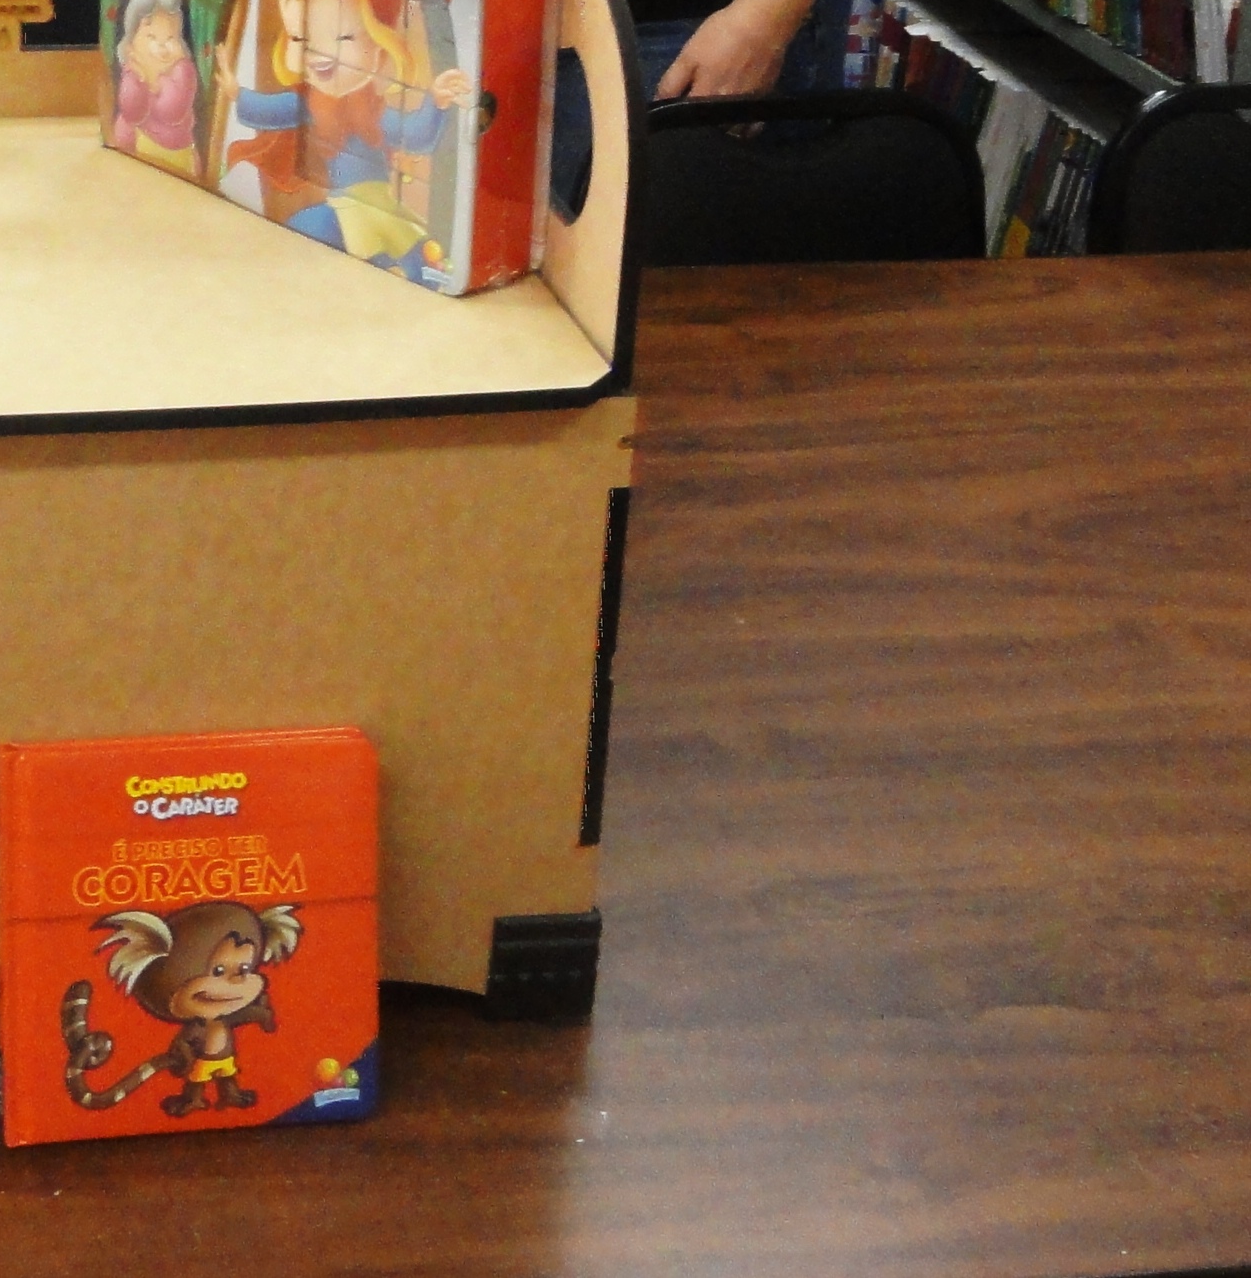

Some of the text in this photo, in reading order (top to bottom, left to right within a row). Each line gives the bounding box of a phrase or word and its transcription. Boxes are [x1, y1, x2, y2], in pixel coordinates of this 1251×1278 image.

[150, 793, 239, 820] CARÁTER
[112, 838, 128, 862] É
[132, 837, 224, 861] PRECISO
[72, 853, 308, 907] CORAGEM
